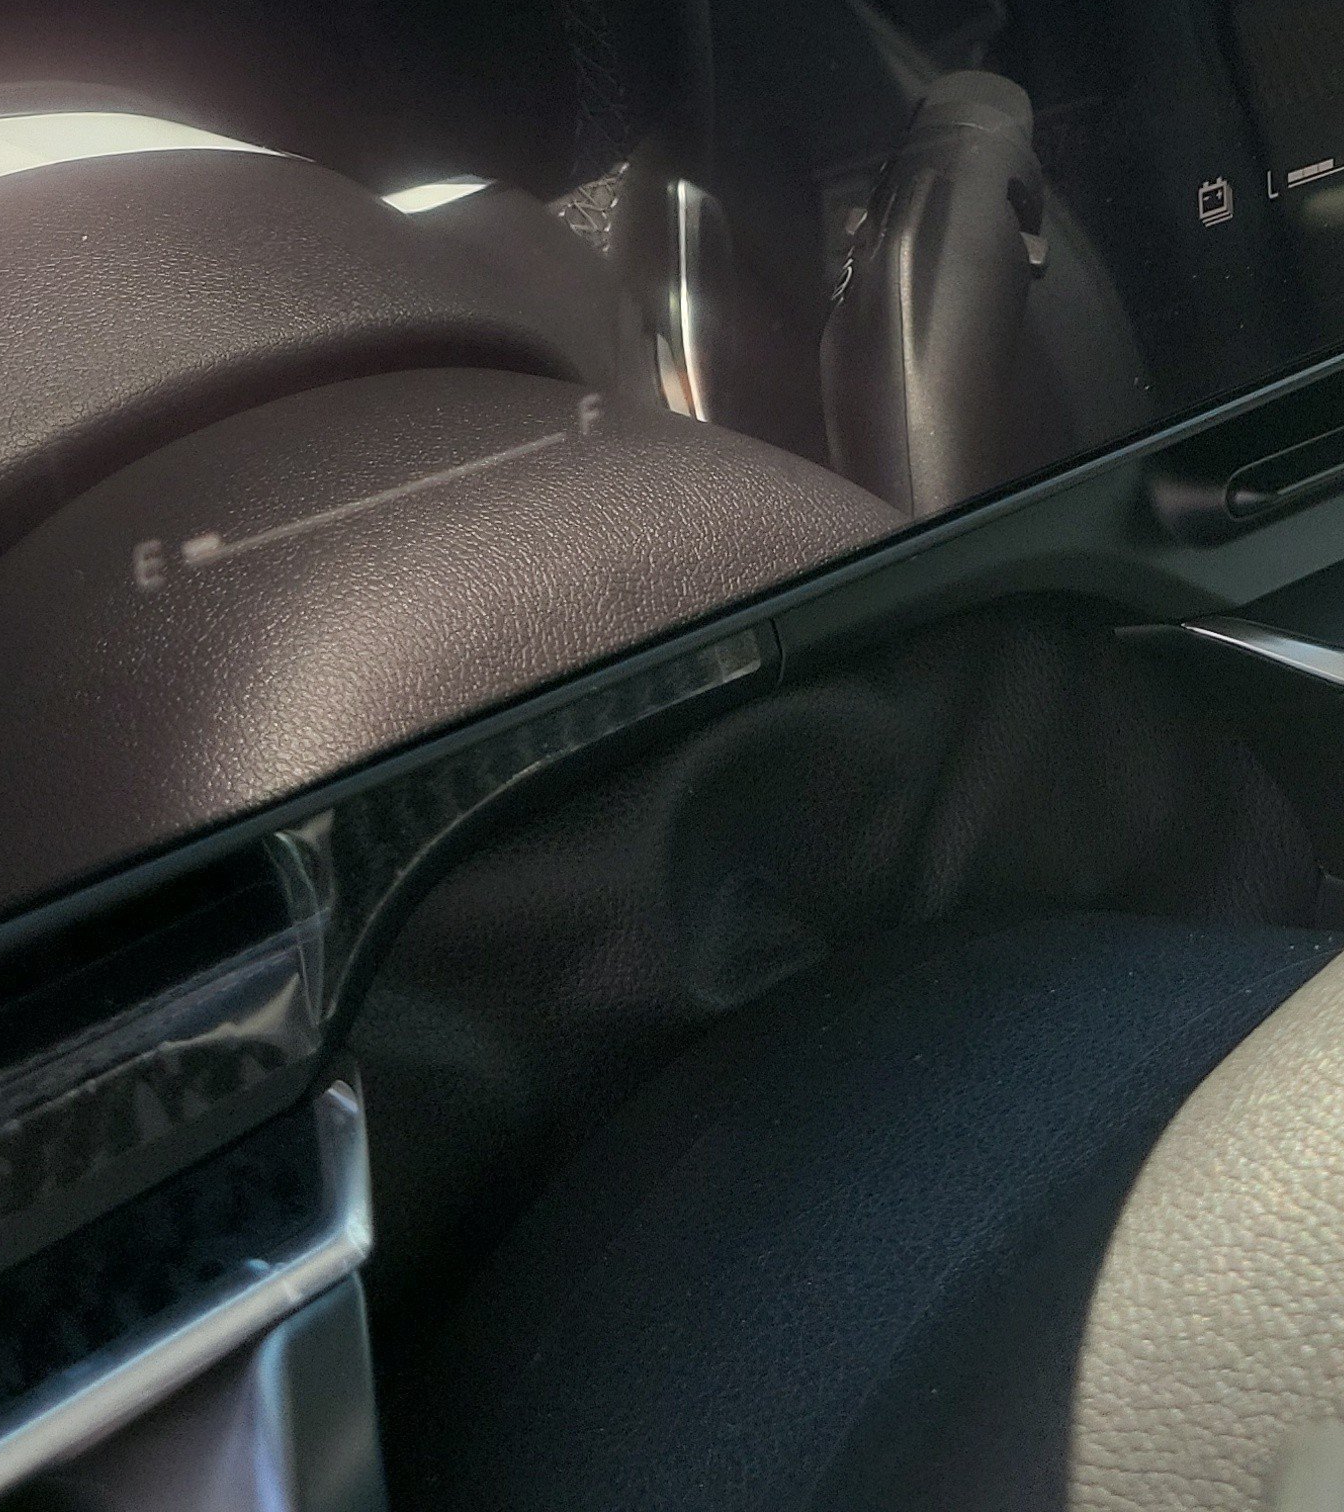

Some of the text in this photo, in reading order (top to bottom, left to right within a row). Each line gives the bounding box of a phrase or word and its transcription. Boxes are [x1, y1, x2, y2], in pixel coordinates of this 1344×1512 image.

[1267, 170, 1279, 199] L
[132, 394, 600, 588] E F
